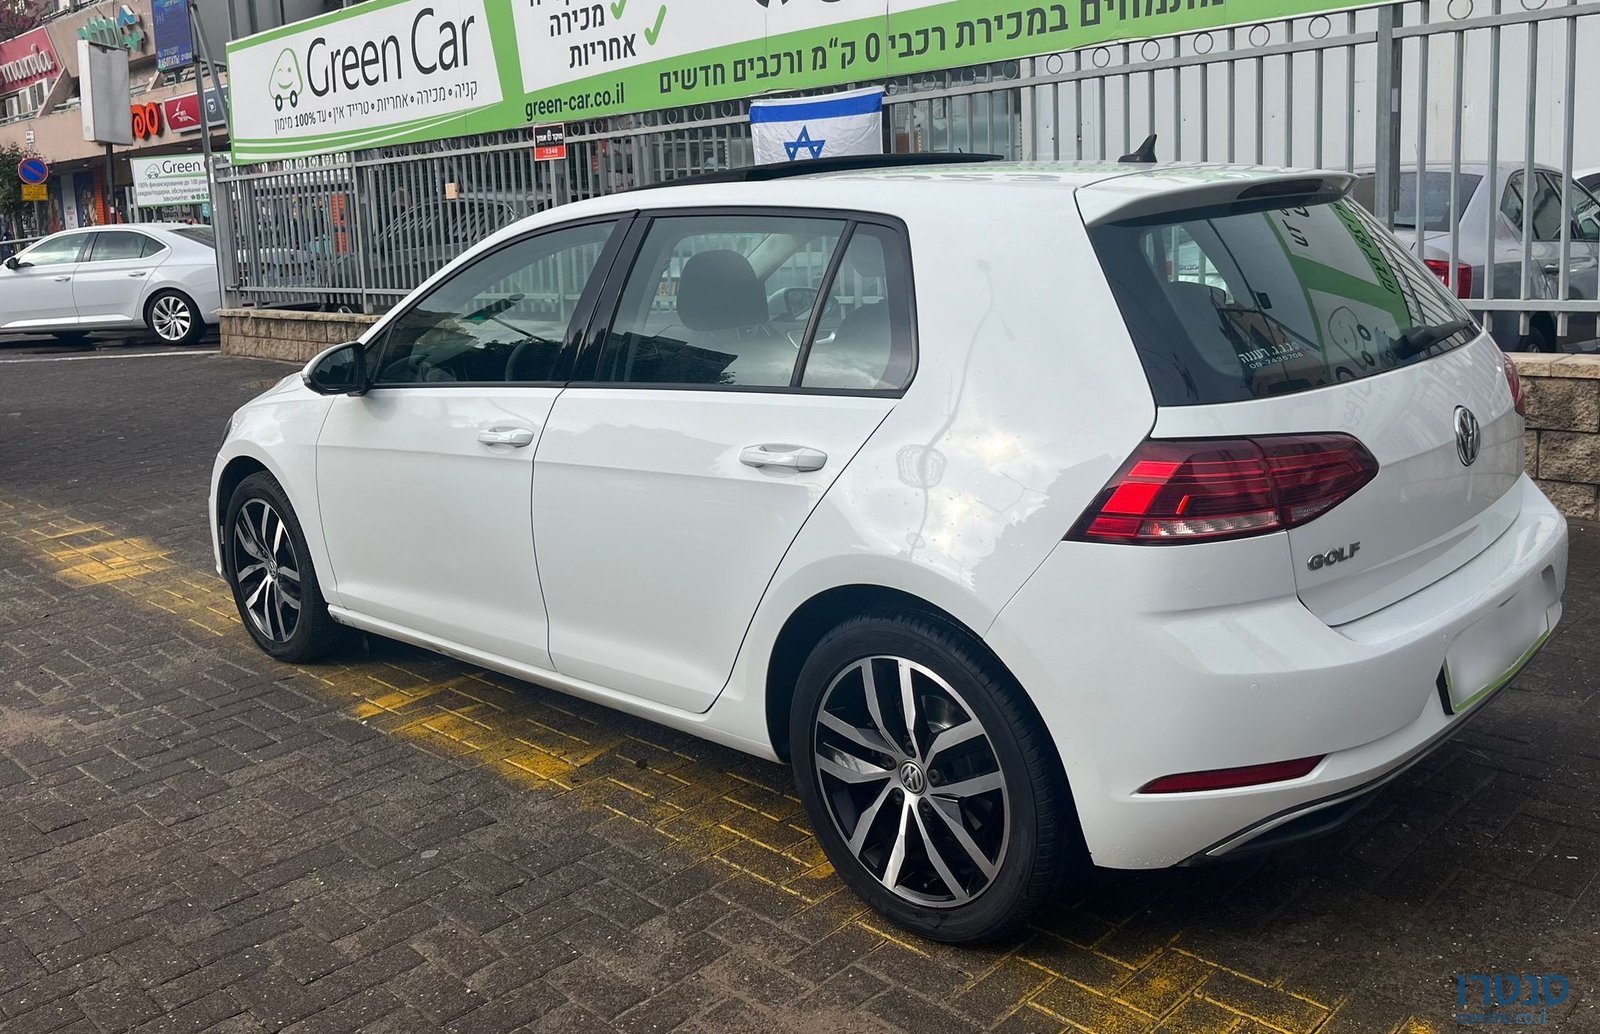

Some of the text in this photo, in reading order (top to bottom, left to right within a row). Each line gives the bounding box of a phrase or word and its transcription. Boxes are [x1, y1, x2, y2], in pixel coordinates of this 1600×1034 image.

[549, 4, 604, 37] מכירה
[955, 4, 1068, 48] במכירת
[306, 8, 475, 97] Green Car
[569, 33, 636, 68] אחריות
[865, 32, 880, 63] 0
[888, 26, 945, 58] רכבי
[659, 63, 726, 94] חדשים
[733, 49, 803, 83] ורכבים
[274, 80, 478, 135] קניה מכירה אחריות טרייד אין עד 100% מימון
[525, 82, 625, 122] green-car.co.il
[162, 160, 201, 174] Green
[1307, 540, 1361, 571] GOLF
